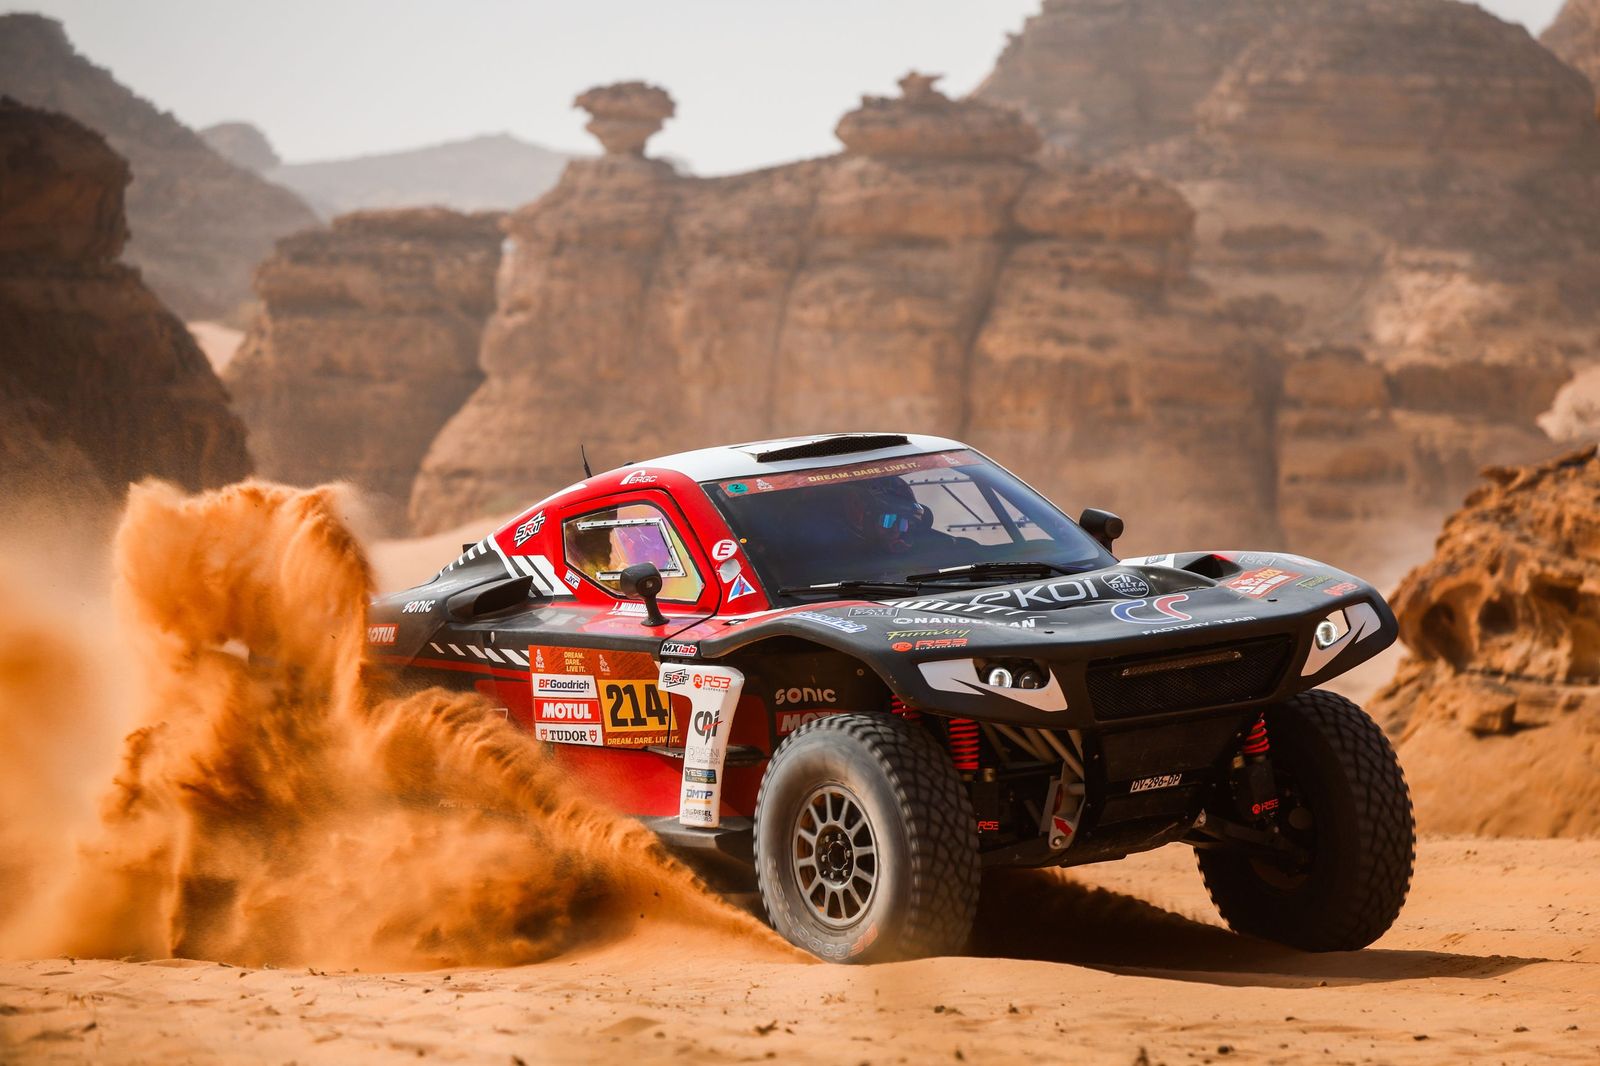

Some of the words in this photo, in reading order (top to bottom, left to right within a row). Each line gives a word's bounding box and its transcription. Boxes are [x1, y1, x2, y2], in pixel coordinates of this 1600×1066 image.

[807, 472, 852, 482] DREAM.
[852, 466, 885, 477] DARE.
[884, 463, 907, 473] LIVE
[907, 461, 921, 469] IT.
[717, 542, 732, 557] E
[1111, 581, 1146, 589] DELTA
[1141, 621, 1209, 635] FACTORY
[1213, 615, 1257, 625] TEAM
[368, 626, 396, 643] OTUL
[563, 651, 585, 659] DREAM.
[662, 643, 697, 654] MXlab
[565, 658, 582, 666] DARE.
[538, 679, 590, 690] BFGoodrich
[541, 702, 592, 719] MOTUL
[605, 684, 669, 727] 214
[549, 730, 588, 742] TUDOR
[607, 737, 634, 746] DREAM.
[634, 737, 655, 745] DARE.
[1132, 774, 1180, 791] DV-296-DP
